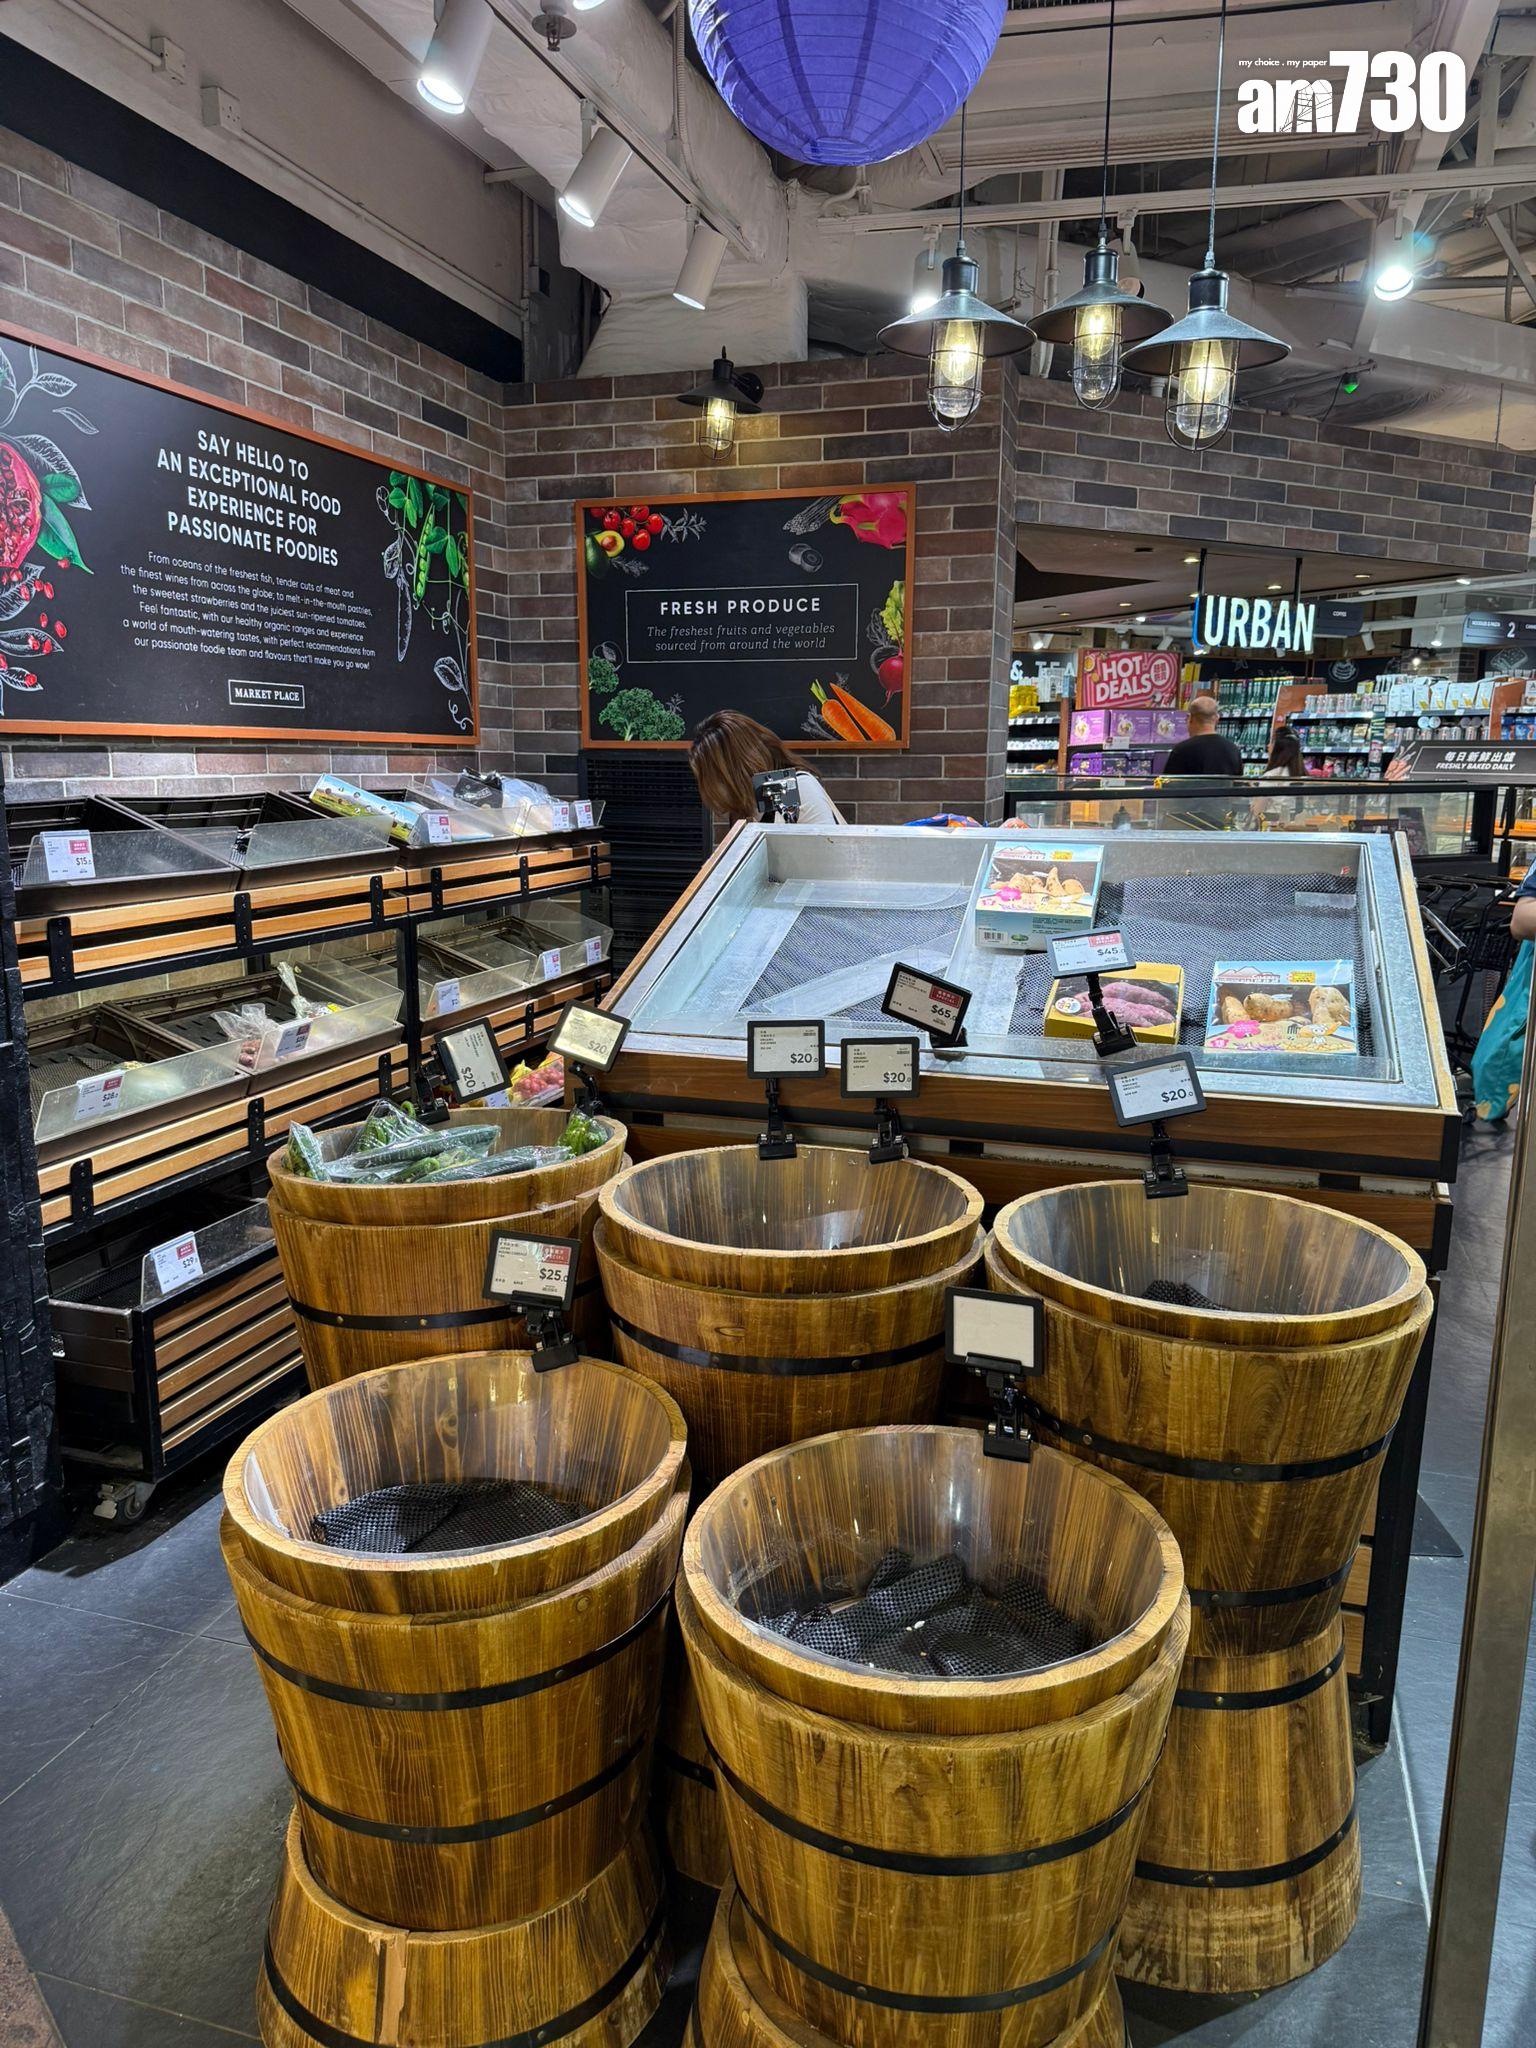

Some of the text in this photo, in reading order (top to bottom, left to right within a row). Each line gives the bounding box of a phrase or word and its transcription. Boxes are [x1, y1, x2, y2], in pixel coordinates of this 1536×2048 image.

[198, 430, 309, 480] SAY HELLO TO
[157, 449, 341, 516] AN EXCEPTIONAL FOOD
[188, 486, 317, 536] EXPERIENCE FOR
[168, 511, 338, 567] PASSIONATE FOODIES
[120, 564, 136, 576] the
[138, 567, 162, 581] finest
[165, 573, 188, 585] wines
[190, 576, 209, 588] from
[210, 581, 236, 593] across
[238, 585, 250, 595] the
[276, 592, 284, 601] to
[286, 594, 347, 612] melt-in-the-mouth
[148, 551, 354, 598] From oceans of the freshest fish, tender cuts of meat and
[132, 584, 148, 596] the
[150, 588, 189, 602] sweetest
[190, 593, 239, 610] strawberries
[240, 602, 255, 611] and
[257, 603, 269, 613] the
[270, 605, 295, 618] juiciest
[297, 610, 336, 624] sun-ripened
[140, 601, 364, 642] Feel fantastic, with our healthy organic ranges and experience
[660, 598, 820, 615] FRESH PRODUCE
[123, 619, 376, 657] a world of mouth-watering tastes, with perfect recommendations from
[647, 623, 835, 640] The freshest fruits and vegetables
[1204, 595, 1315, 654] URBAN
[1507, 621, 1516, 638] 2
[134, 637, 149, 647] our
[152, 639, 198, 652] passionate
[200, 642, 226, 654] foodie
[227, 646, 248, 657] team
[249, 649, 263, 659] and
[265, 649, 292, 661] flavours
[314, 656, 331, 666] make
[333, 659, 344, 668] you
[346, 660, 354, 670] go
[355, 661, 370, 670] wow!
[656, 637, 826, 653] sourced from around the world
[1102, 655, 1143, 682] HOT
[234, 688, 299, 701] MARKET PLACE
[1095, 673, 1152, 702] DEALS
[1436, 762, 1465, 770] FRESHLY
[1492, 763, 1516, 771] DAILY
[1444, 751, 1516, 763] 每日新鮮出爐
